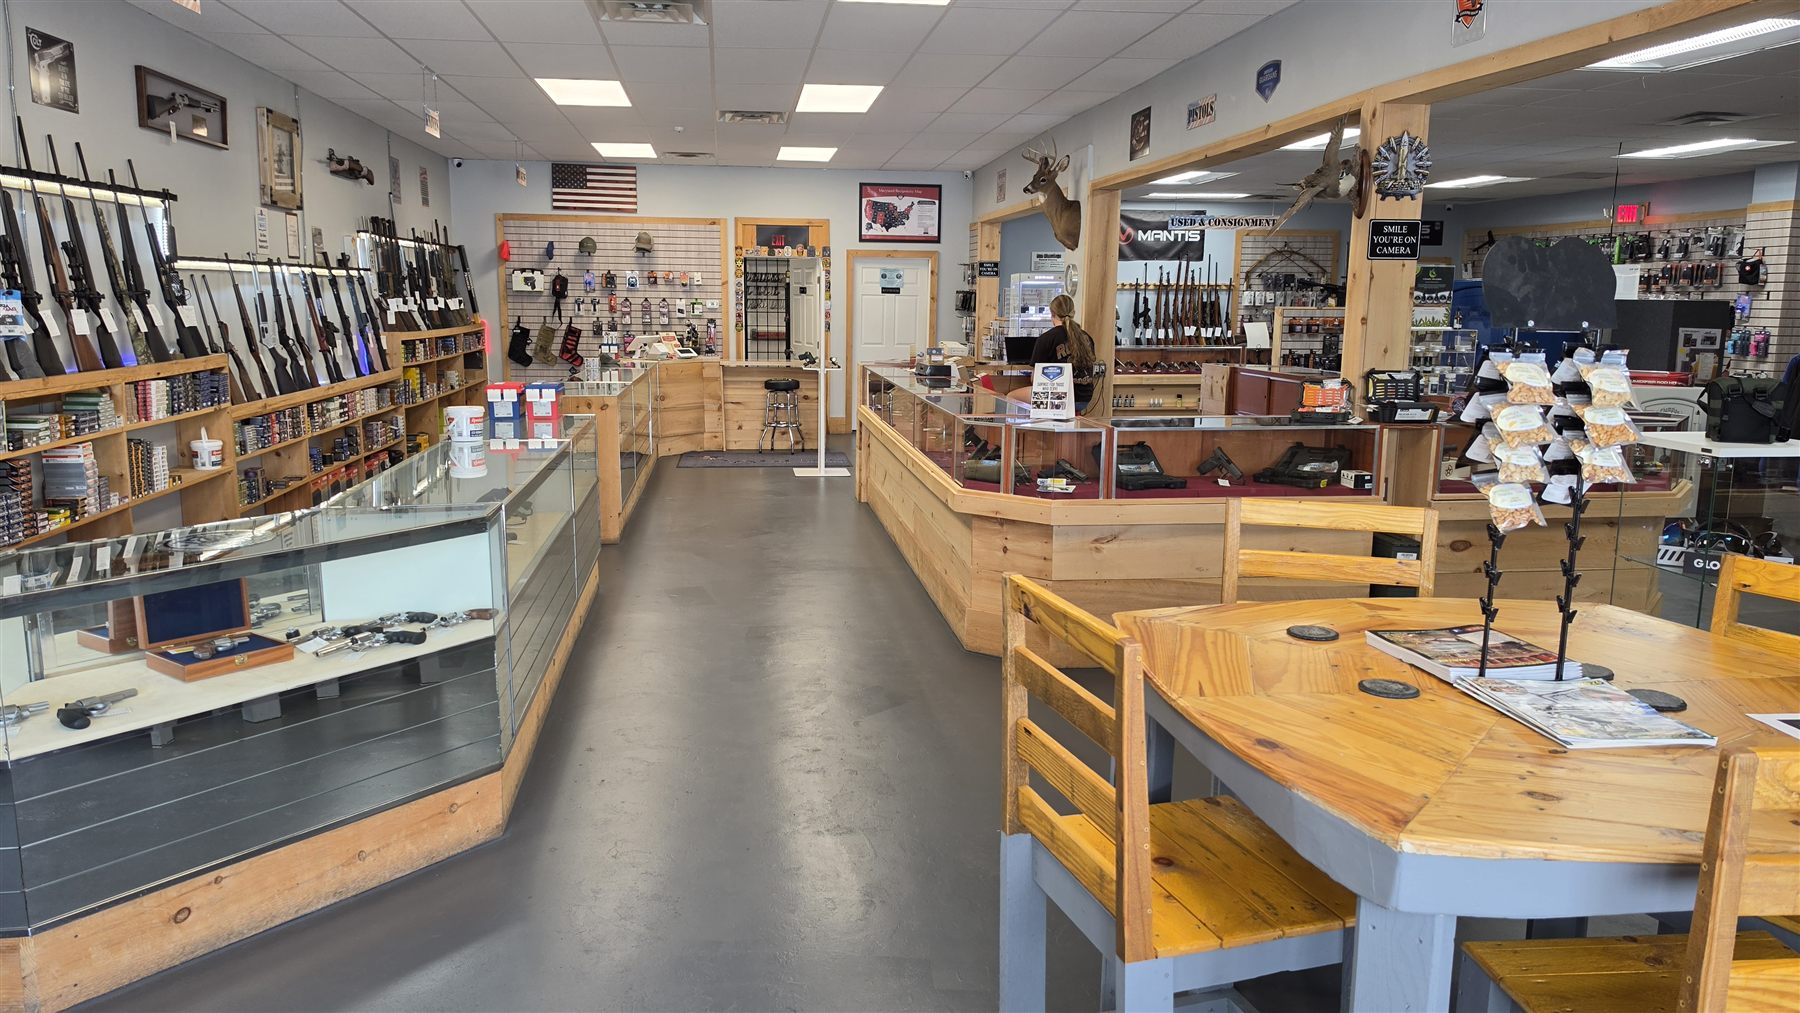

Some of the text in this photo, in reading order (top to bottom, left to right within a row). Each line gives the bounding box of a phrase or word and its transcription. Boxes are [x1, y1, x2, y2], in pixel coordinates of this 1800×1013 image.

[1188, 101, 1214, 123] PISTOLS
[1617, 205, 1640, 223] EXIT
[1171, 217, 1278, 228] USED & CONSIGNMENT
[1383, 225, 1408, 234] SMILE
[1137, 230, 1200, 242] MANTIS
[1373, 235, 1417, 244] YOU'RE ON
[1376, 246, 1411, 254] CAMERA
[1694, 558, 1720, 570] GLO
